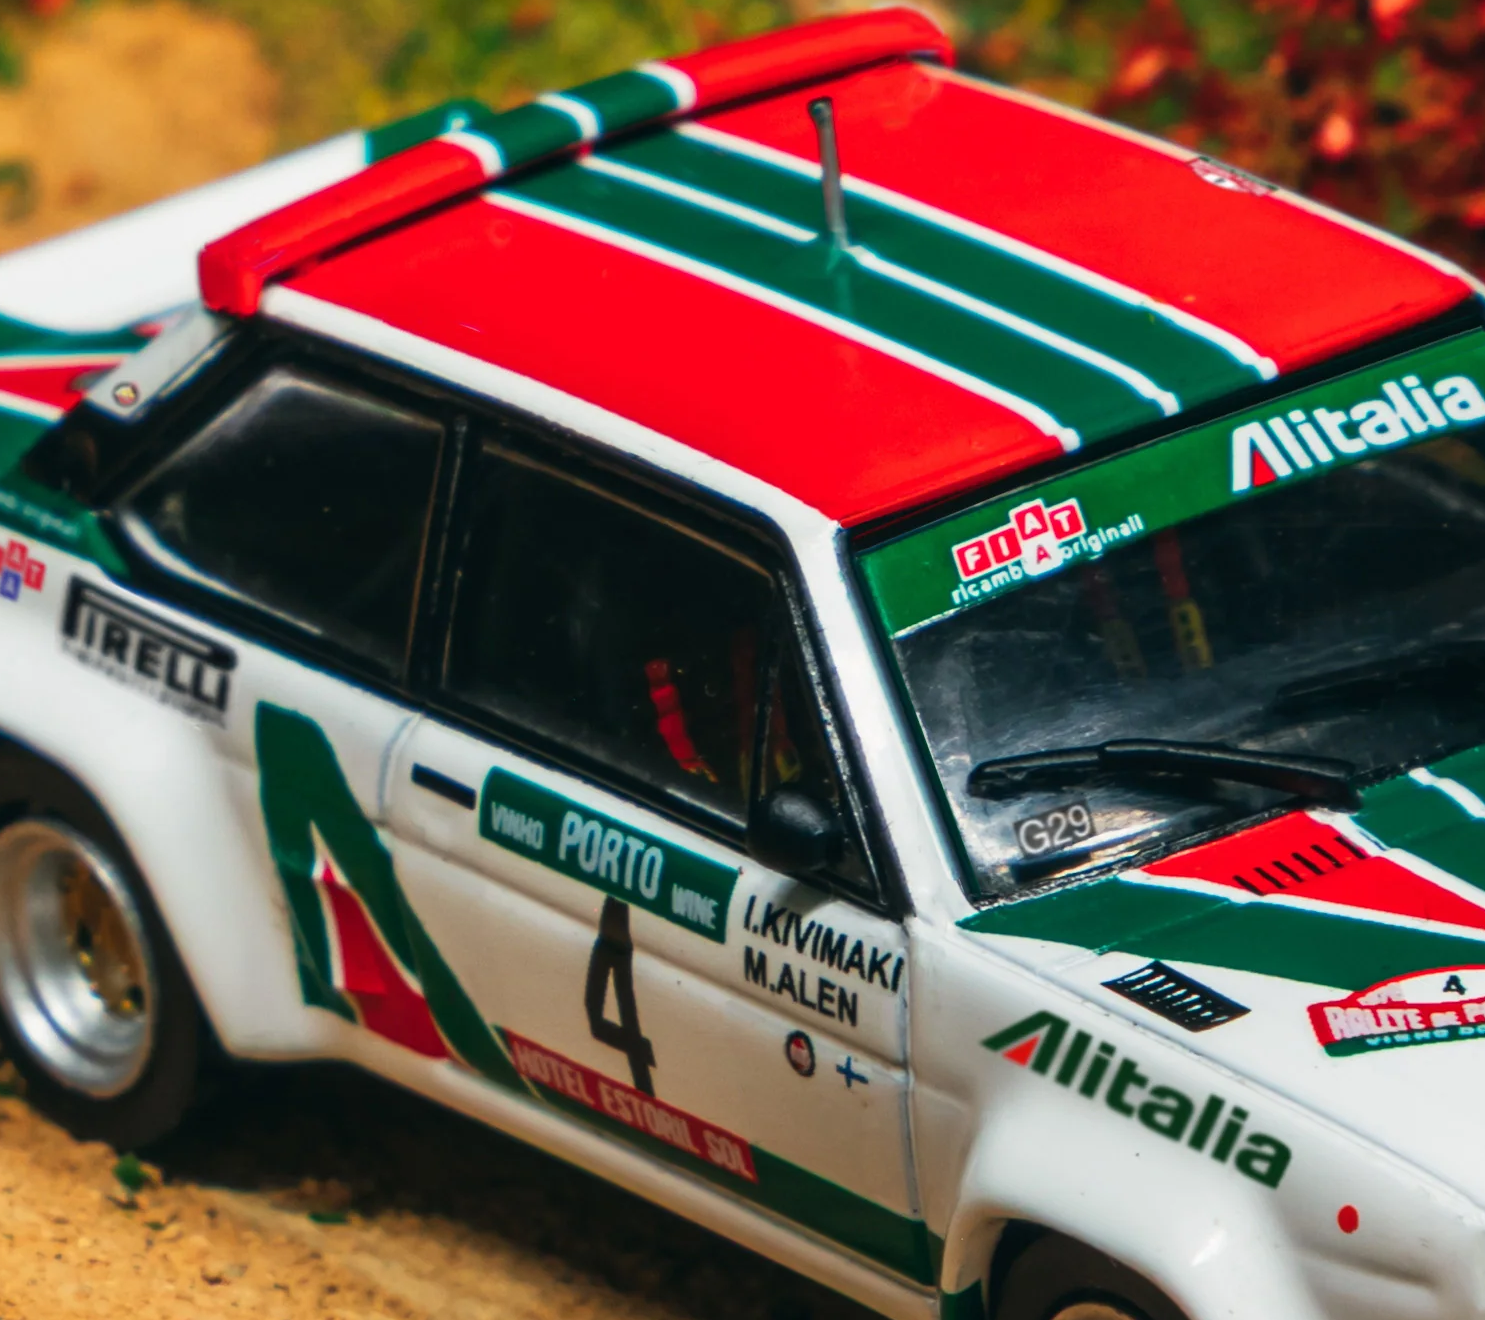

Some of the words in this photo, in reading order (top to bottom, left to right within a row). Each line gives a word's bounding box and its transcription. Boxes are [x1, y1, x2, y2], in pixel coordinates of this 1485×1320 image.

[953, 500, 1085, 580] FIAT
[63, 573, 237, 713] PIRELLI
[491, 801, 544, 850] VINHO
[558, 811, 664, 900] PORTO
[671, 883, 719, 930] WINE
[1019, 804, 1091, 854] G29
[585, 895, 656, 1098] 4
[744, 895, 905, 993] I.KIVIMAKI
[745, 945, 858, 1027] M.ALEN
[513, 1040, 596, 1107] HOTEL
[597, 1080, 703, 1157] ESTORIL
[702, 1129, 758, 1180] SOL
[981, 1010, 1293, 1189] Alitalia
